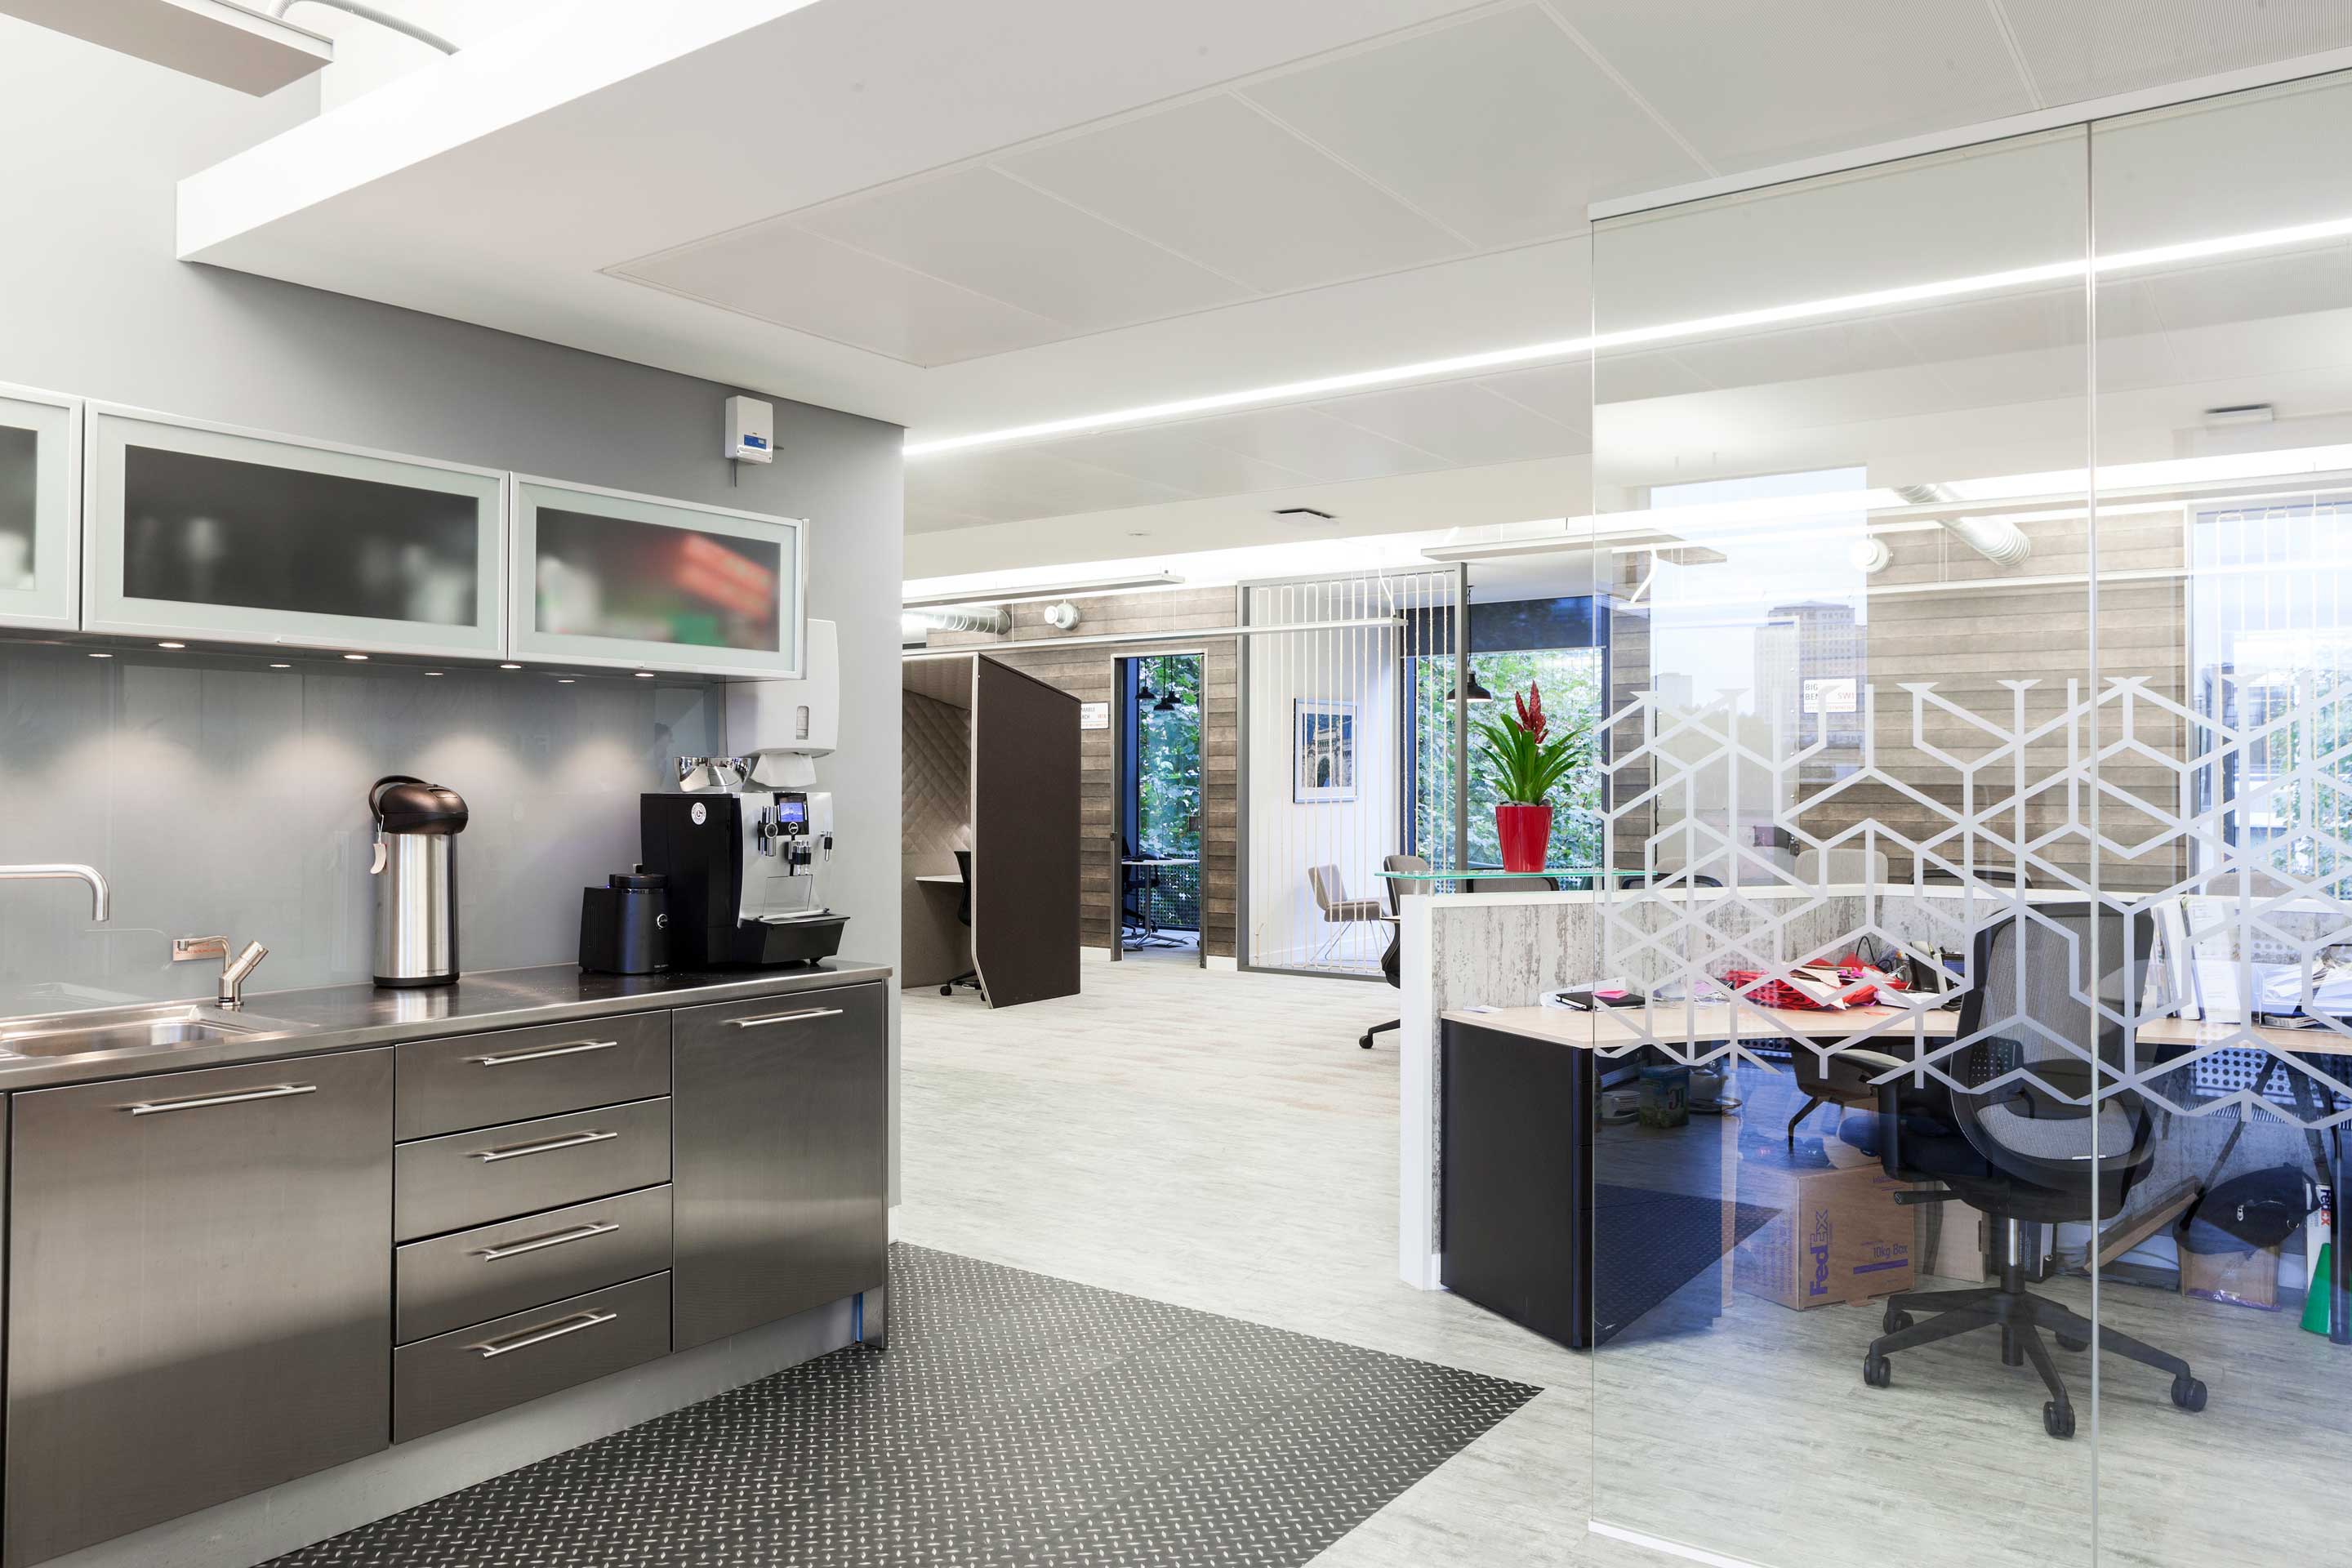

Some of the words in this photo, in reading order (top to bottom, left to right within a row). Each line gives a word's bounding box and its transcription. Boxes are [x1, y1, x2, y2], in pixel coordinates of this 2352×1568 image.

[1837, 692, 1855, 700] SW1
[1810, 1209, 1830, 1297] FedEx
[1873, 1245, 1891, 1261] 10kg
[1892, 1243, 1909, 1256] Box
